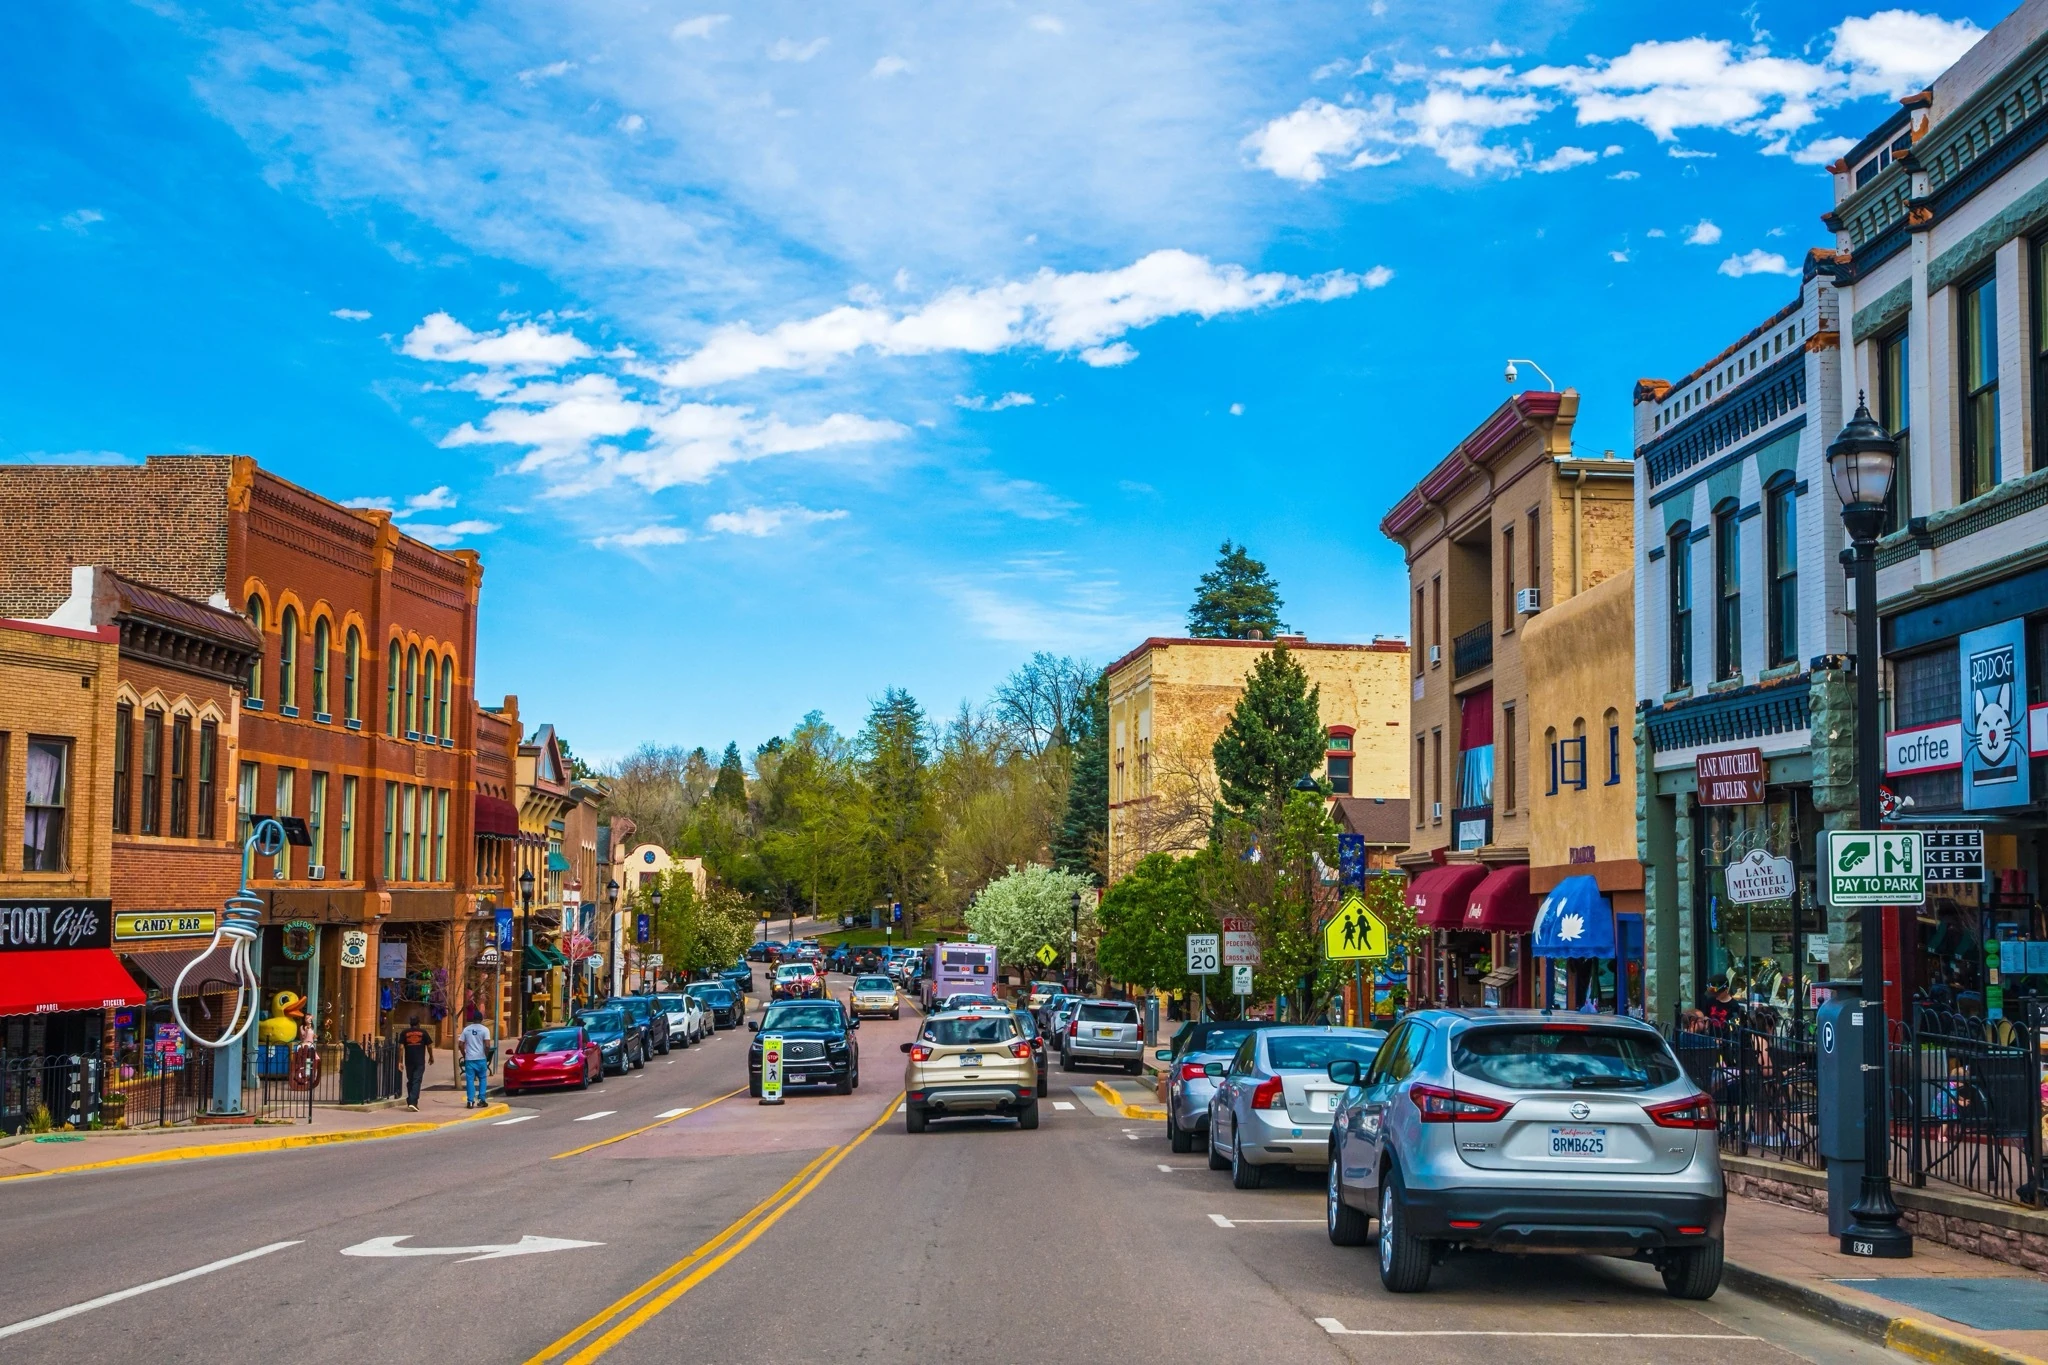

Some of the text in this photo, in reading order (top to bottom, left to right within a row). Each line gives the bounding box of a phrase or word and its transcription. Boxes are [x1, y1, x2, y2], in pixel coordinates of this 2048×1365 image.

[1972, 653, 2013, 686] RED DOG
[1898, 735, 1949, 764] coffee
[1698, 752, 1760, 778] LANE MITCHELL
[1712, 780, 1748, 800] JEWELERS
[1927, 834, 1979, 846] FFEE
[1926, 851, 1979, 863] KERY
[1745, 865, 1774, 877] LANE
[1927, 868, 1965, 879] AFE
[1733, 874, 1789, 890] MITCHELL
[1836, 877, 1919, 892] PAY TO PARK
[1738, 885, 1786, 899] JEWELERS
[53, 906, 99, 946] Gifts
[134, 918, 200, 932] CANDY BAR
[283, 920, 315, 933] BAREFOOT
[1190, 938, 1216, 946] SPEED
[1193, 946, 1213, 954] LIMIT
[1191, 955, 1216, 970] 20
[36, 1003, 58, 1012] APPAREL
[103, 998, 126, 1007] STICKERS
[1825, 1026, 1832, 1048] P
[1560, 1127, 1593, 1137] California
[1553, 1137, 1604, 1153] 8RMB625
[1854, 1242, 1872, 1254] 828
